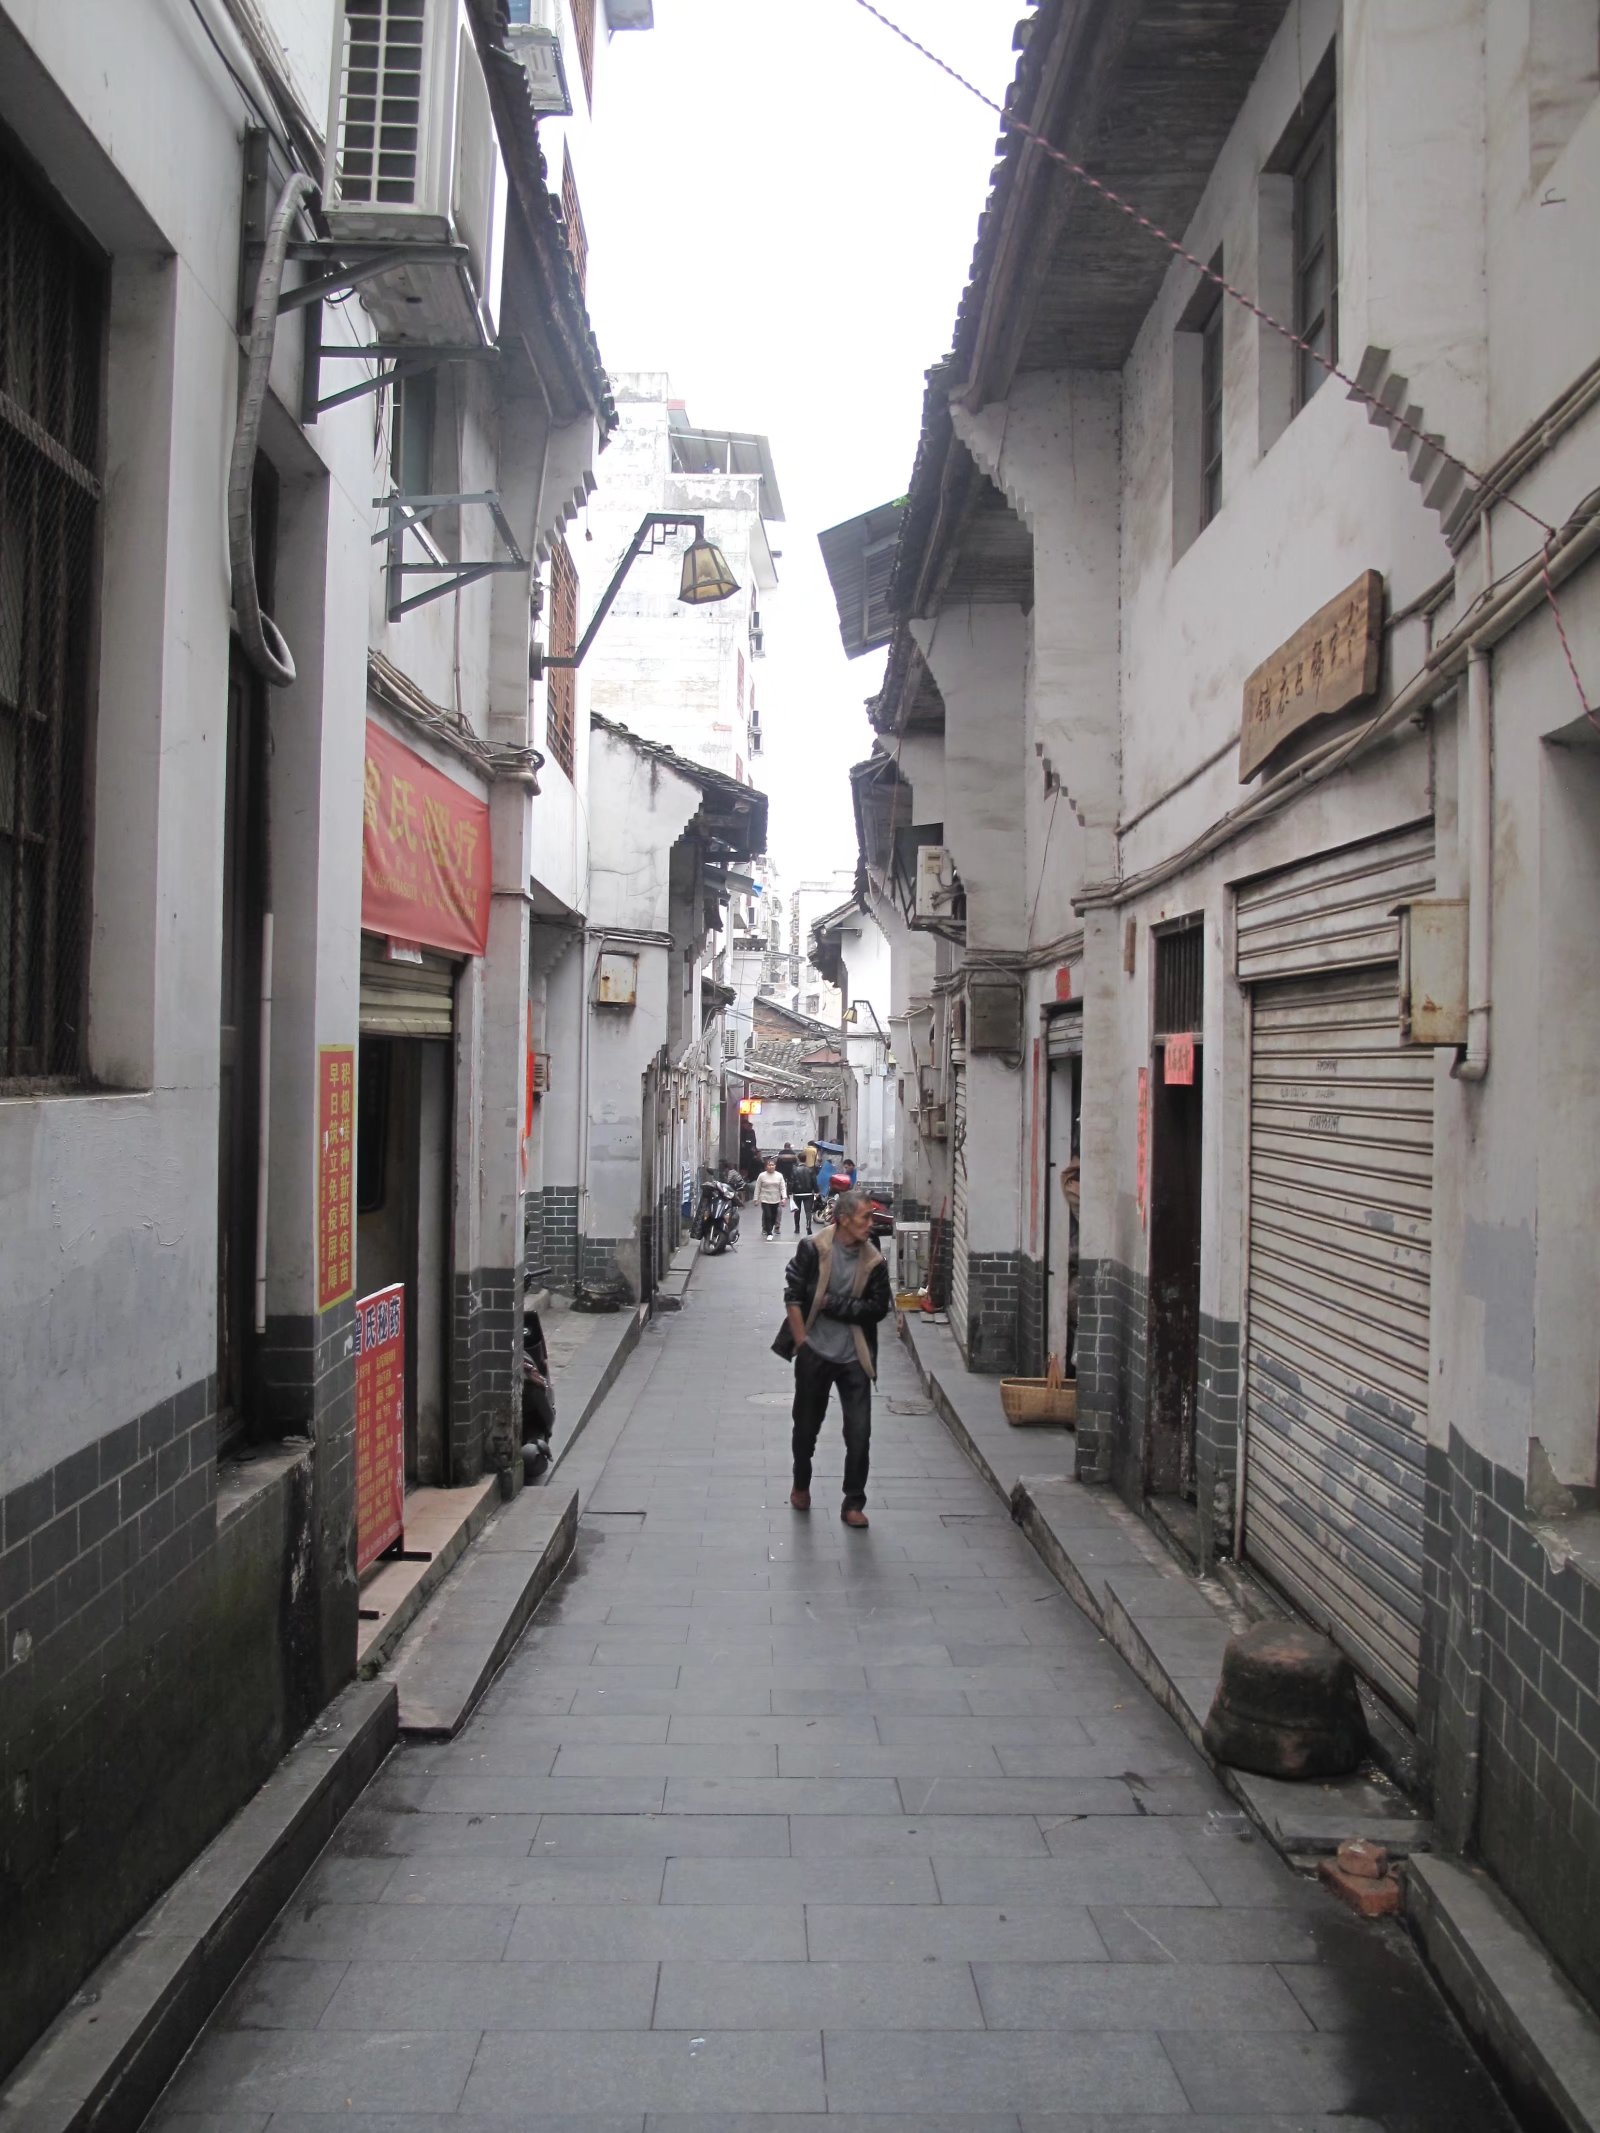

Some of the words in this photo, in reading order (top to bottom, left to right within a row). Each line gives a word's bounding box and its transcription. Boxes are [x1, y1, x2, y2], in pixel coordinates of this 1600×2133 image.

[328, 1063, 339, 1289] 早日筑立免疫屏障
[340, 1063, 351, 1283] 积极接种新冠疫苗
